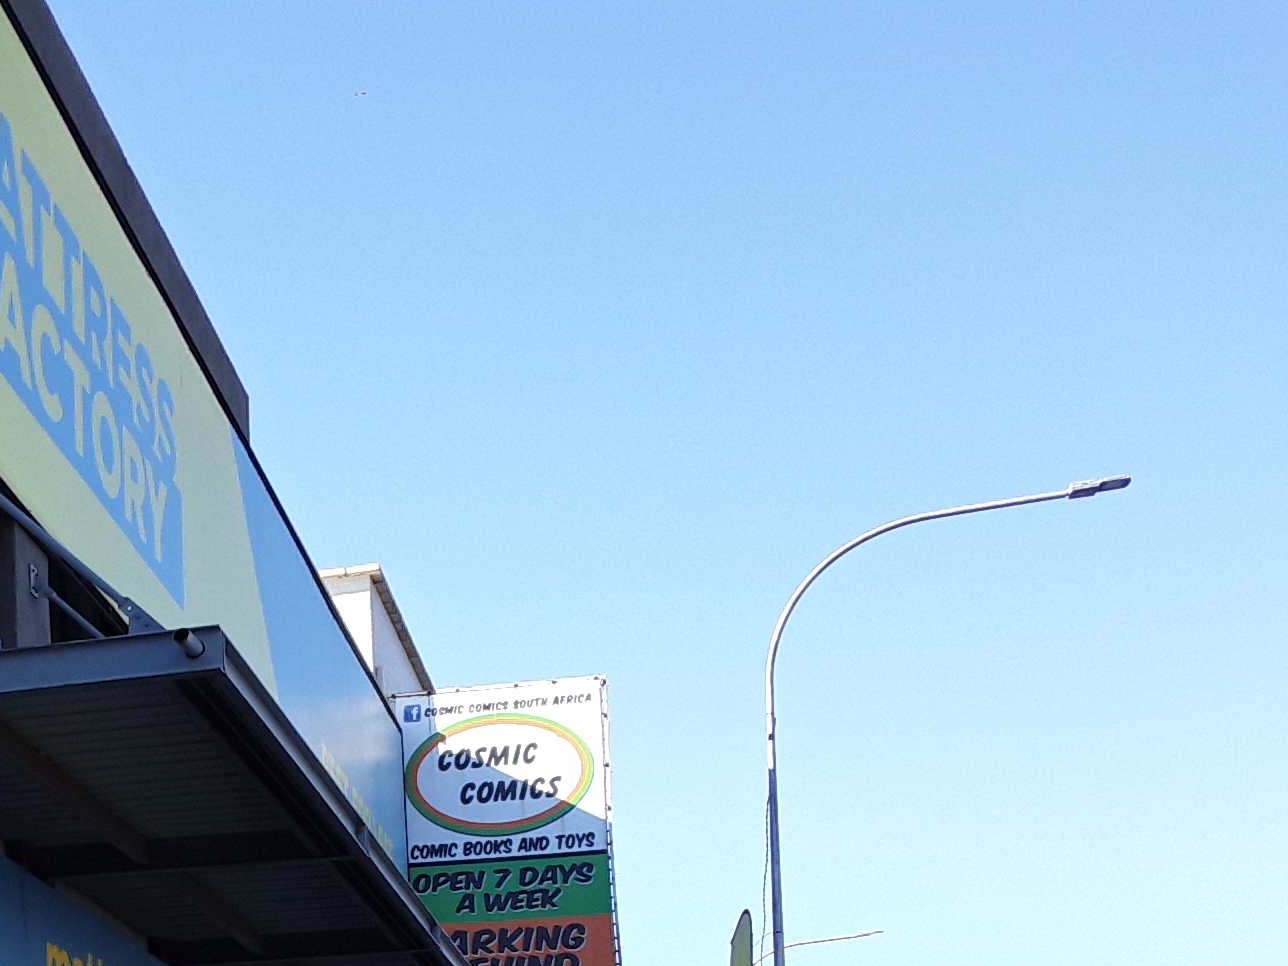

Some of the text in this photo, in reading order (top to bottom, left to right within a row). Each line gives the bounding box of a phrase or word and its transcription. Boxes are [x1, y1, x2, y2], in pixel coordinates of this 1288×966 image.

[424, 705, 464, 718] COSMIC
[469, 701, 509, 713] COMICS
[513, 697, 548, 710] SOUTH
[552, 693, 592, 705] AFRICA
[438, 742, 538, 772] COSMIC
[460, 776, 562, 805] COMICS
[410, 831, 596, 861] COMIC BOOKS AND TOYS
[412, 862, 595, 894] OPEN 7 DAYS
[455, 888, 562, 915] A WEEK
[451, 923, 587, 956] ARKING
